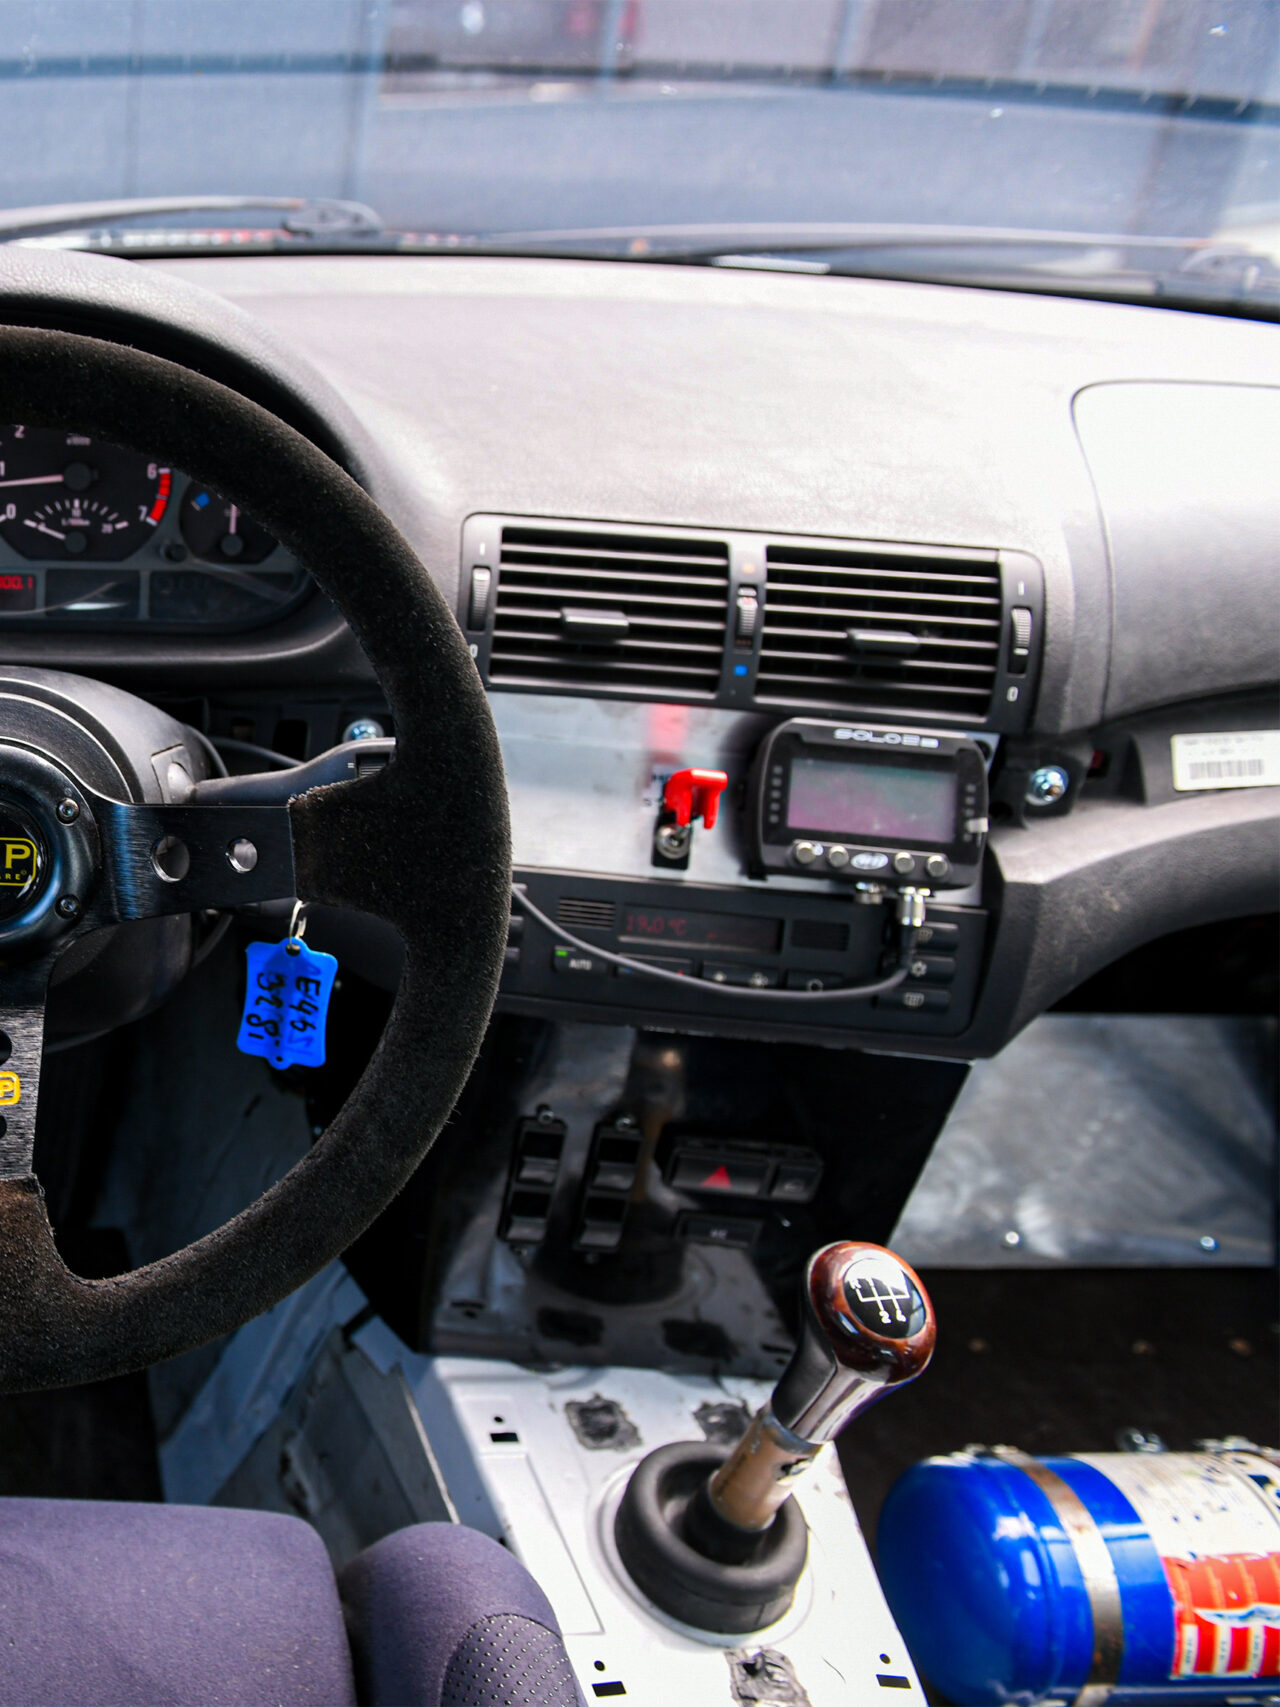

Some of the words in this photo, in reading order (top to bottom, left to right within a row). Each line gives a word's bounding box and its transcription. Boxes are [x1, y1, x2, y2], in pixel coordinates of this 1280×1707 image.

[14, 425, 25, 438] 2
[147, 463, 157, 479] 6
[6, 503, 16, 520] 0
[138, 506, 147, 522] 7
[569, 959, 592, 970] AUTO
[288, 975, 322, 1033] E46
[879, 1310, 892, 1324] 2
